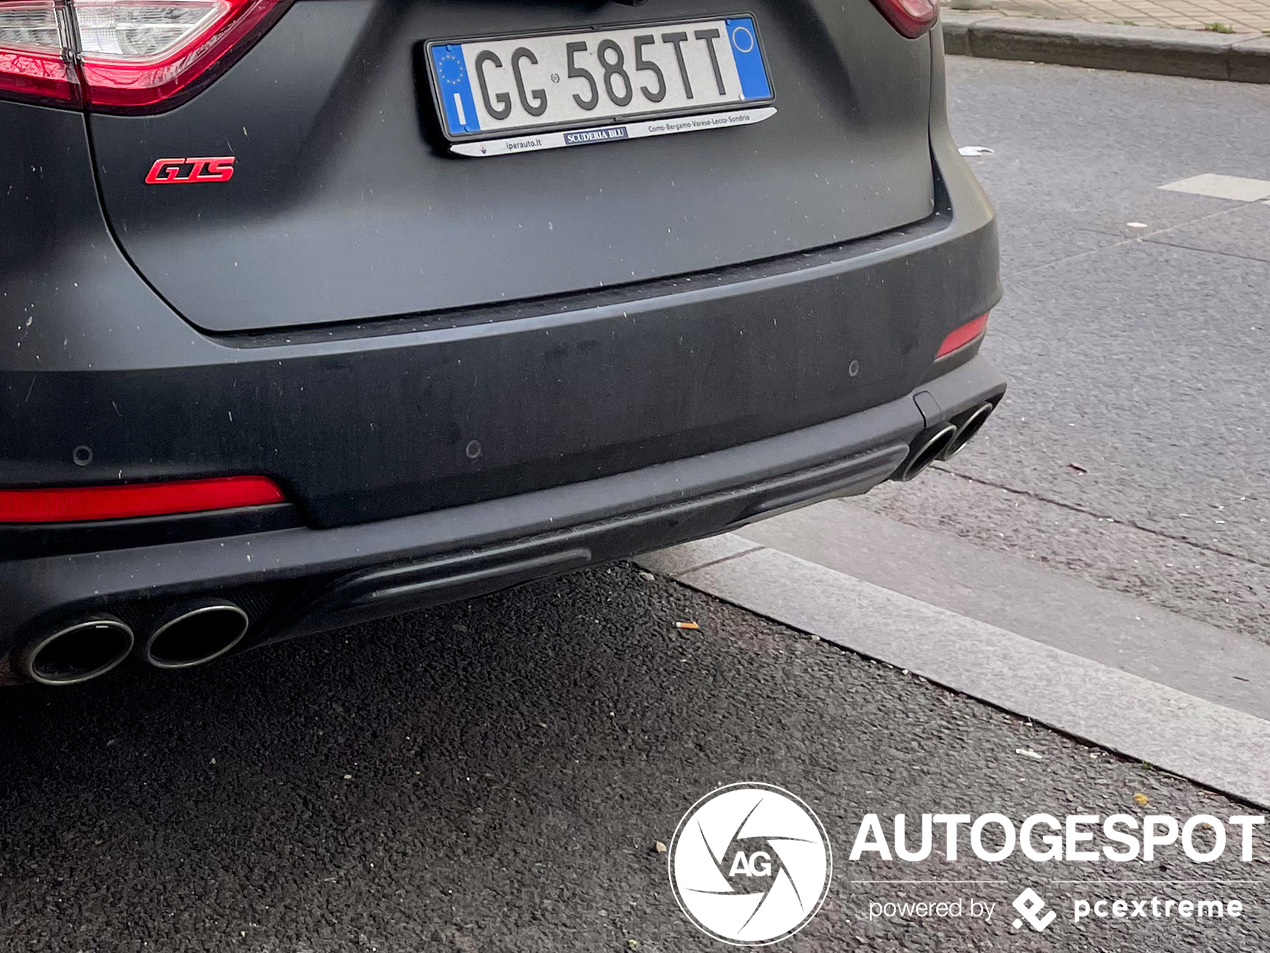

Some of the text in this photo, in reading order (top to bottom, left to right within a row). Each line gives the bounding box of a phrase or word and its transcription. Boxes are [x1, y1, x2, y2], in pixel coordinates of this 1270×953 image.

[474, 28, 726, 120] GG 585TT
[506, 138, 542, 151] iperauto.it
[567, 128, 624, 143] SCUDERIA BLU
[145, 156, 236, 184] GTS
